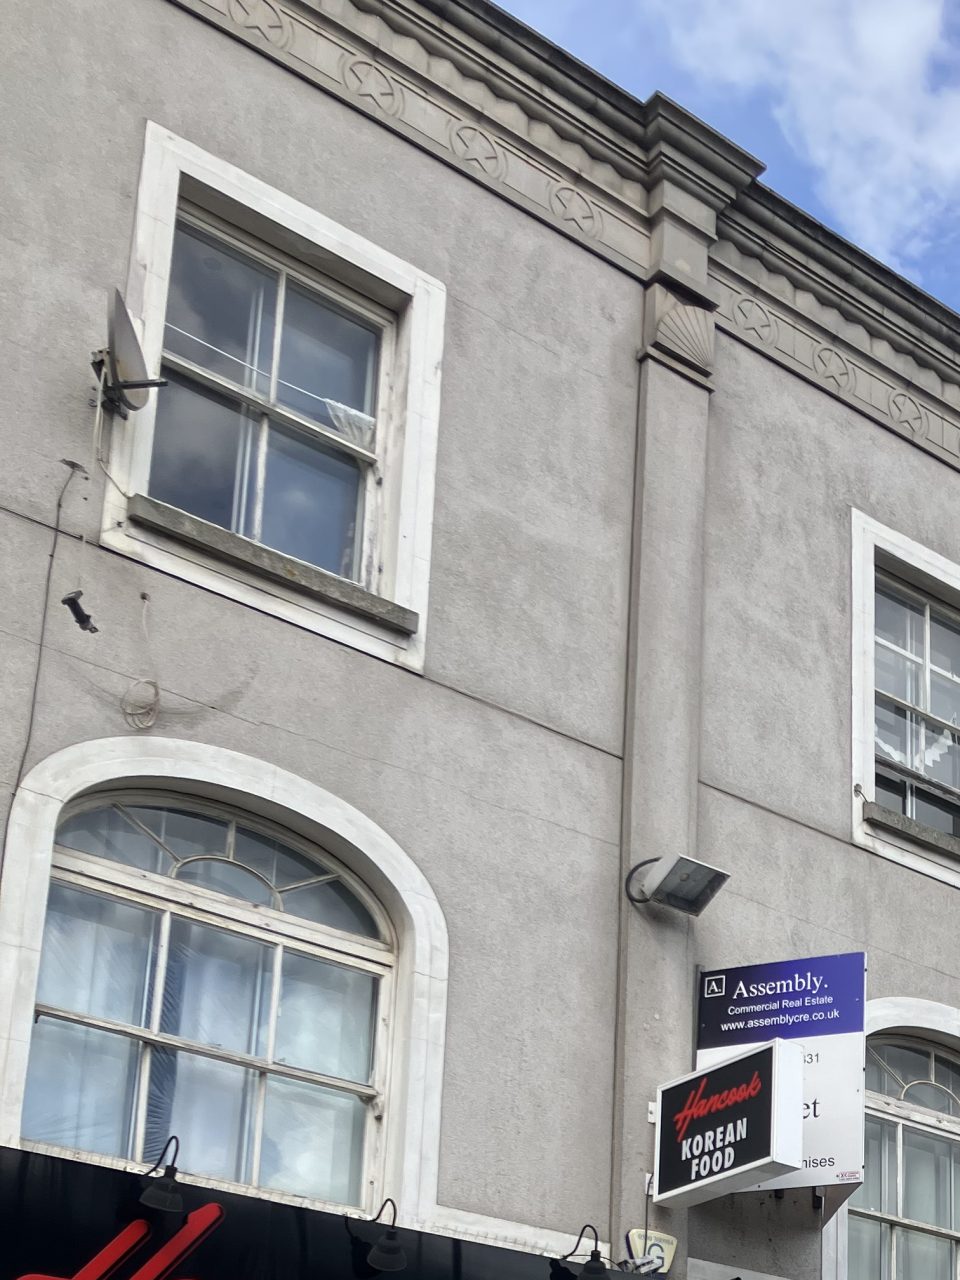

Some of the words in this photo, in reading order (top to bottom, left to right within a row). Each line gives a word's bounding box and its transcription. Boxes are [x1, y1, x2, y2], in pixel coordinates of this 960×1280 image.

[733, 972, 829, 999] Assembly.
[720, 1008, 840, 1031] www.assemblycre.co.uk
[728, 1000, 780, 1016] Commercial
[782, 997, 803, 1009] Real
[804, 994, 834, 1006] Estate
[673, 1071, 762, 1142] Hancook
[680, 1117, 748, 1161] KOREAN
[690, 1146, 735, 1180] FOOD
